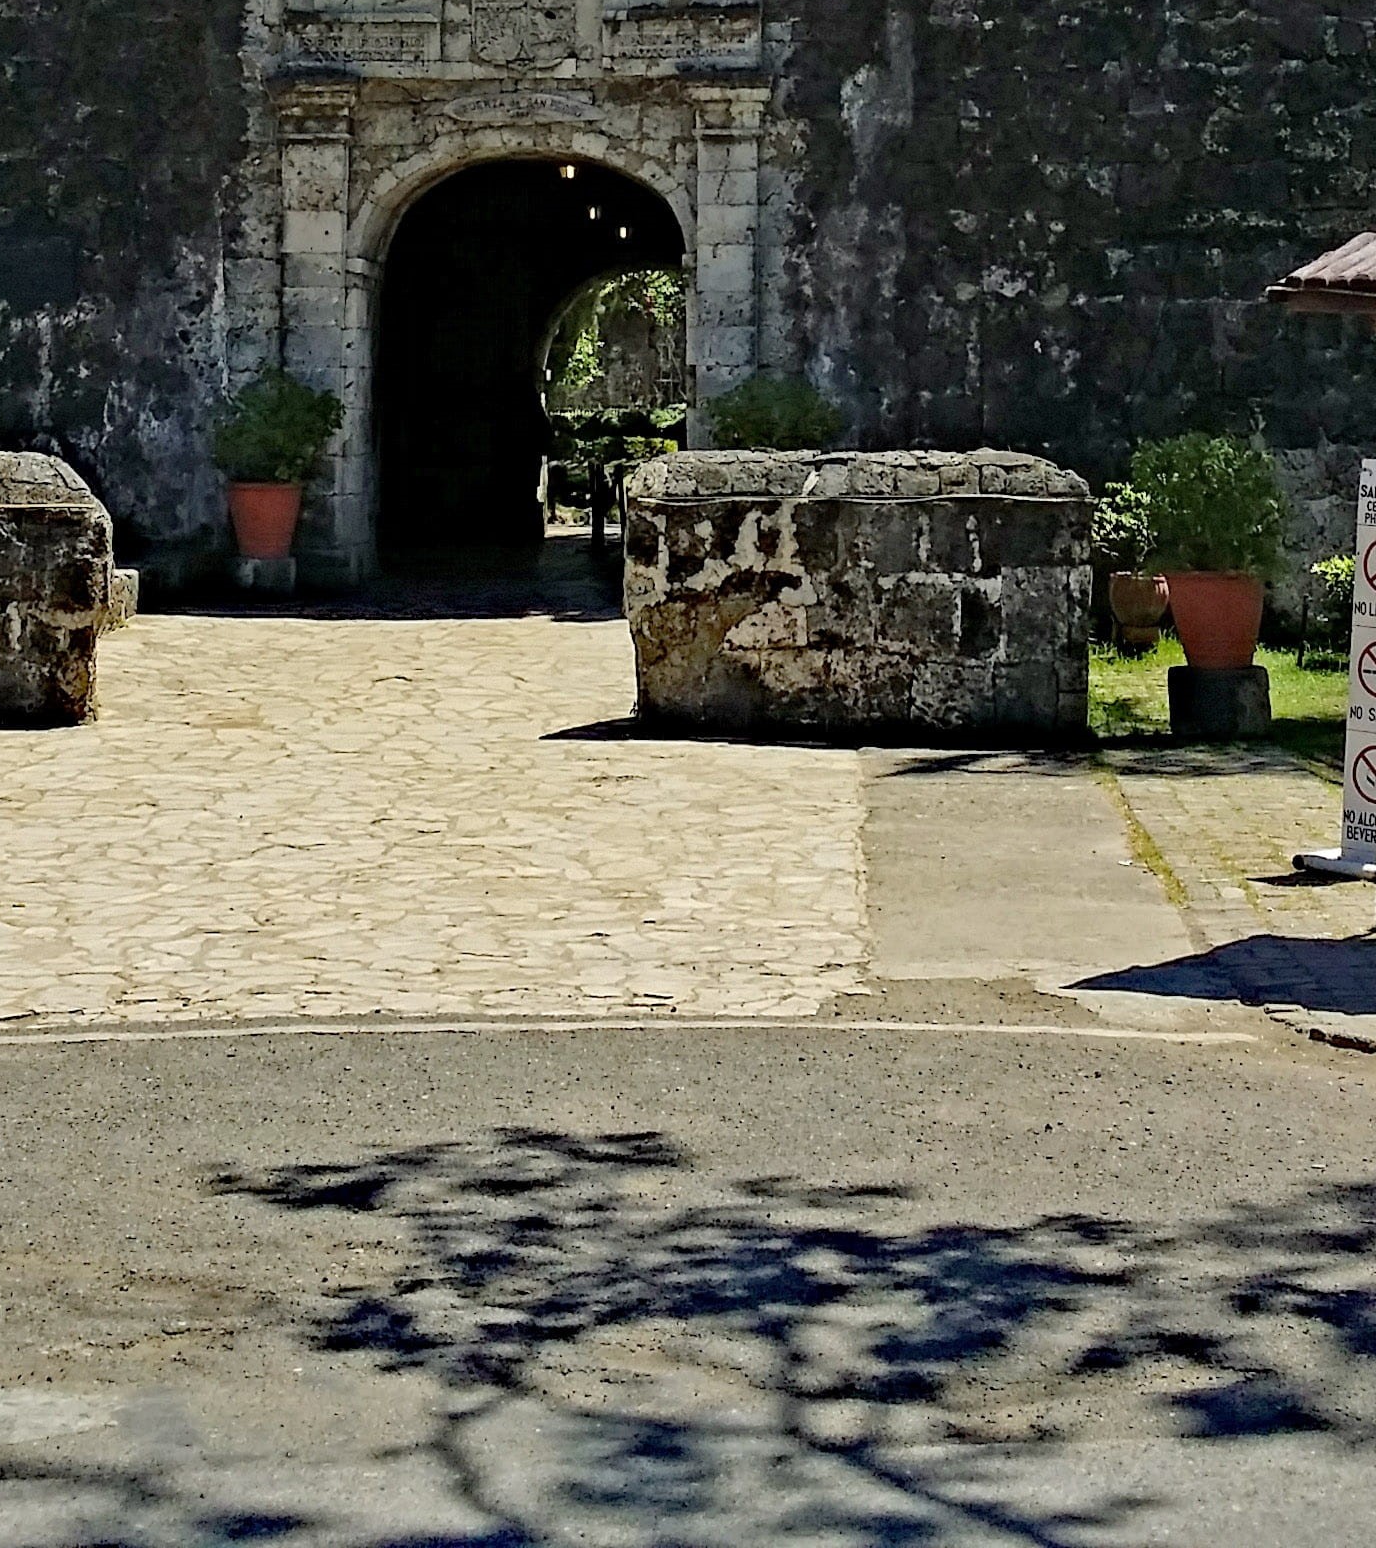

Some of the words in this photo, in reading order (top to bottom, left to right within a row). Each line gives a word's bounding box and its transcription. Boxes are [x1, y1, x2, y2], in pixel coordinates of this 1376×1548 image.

[1354, 601, 1367, 616] NO
[1349, 705, 1363, 720] NO
[1343, 809, 1356, 824] NO
